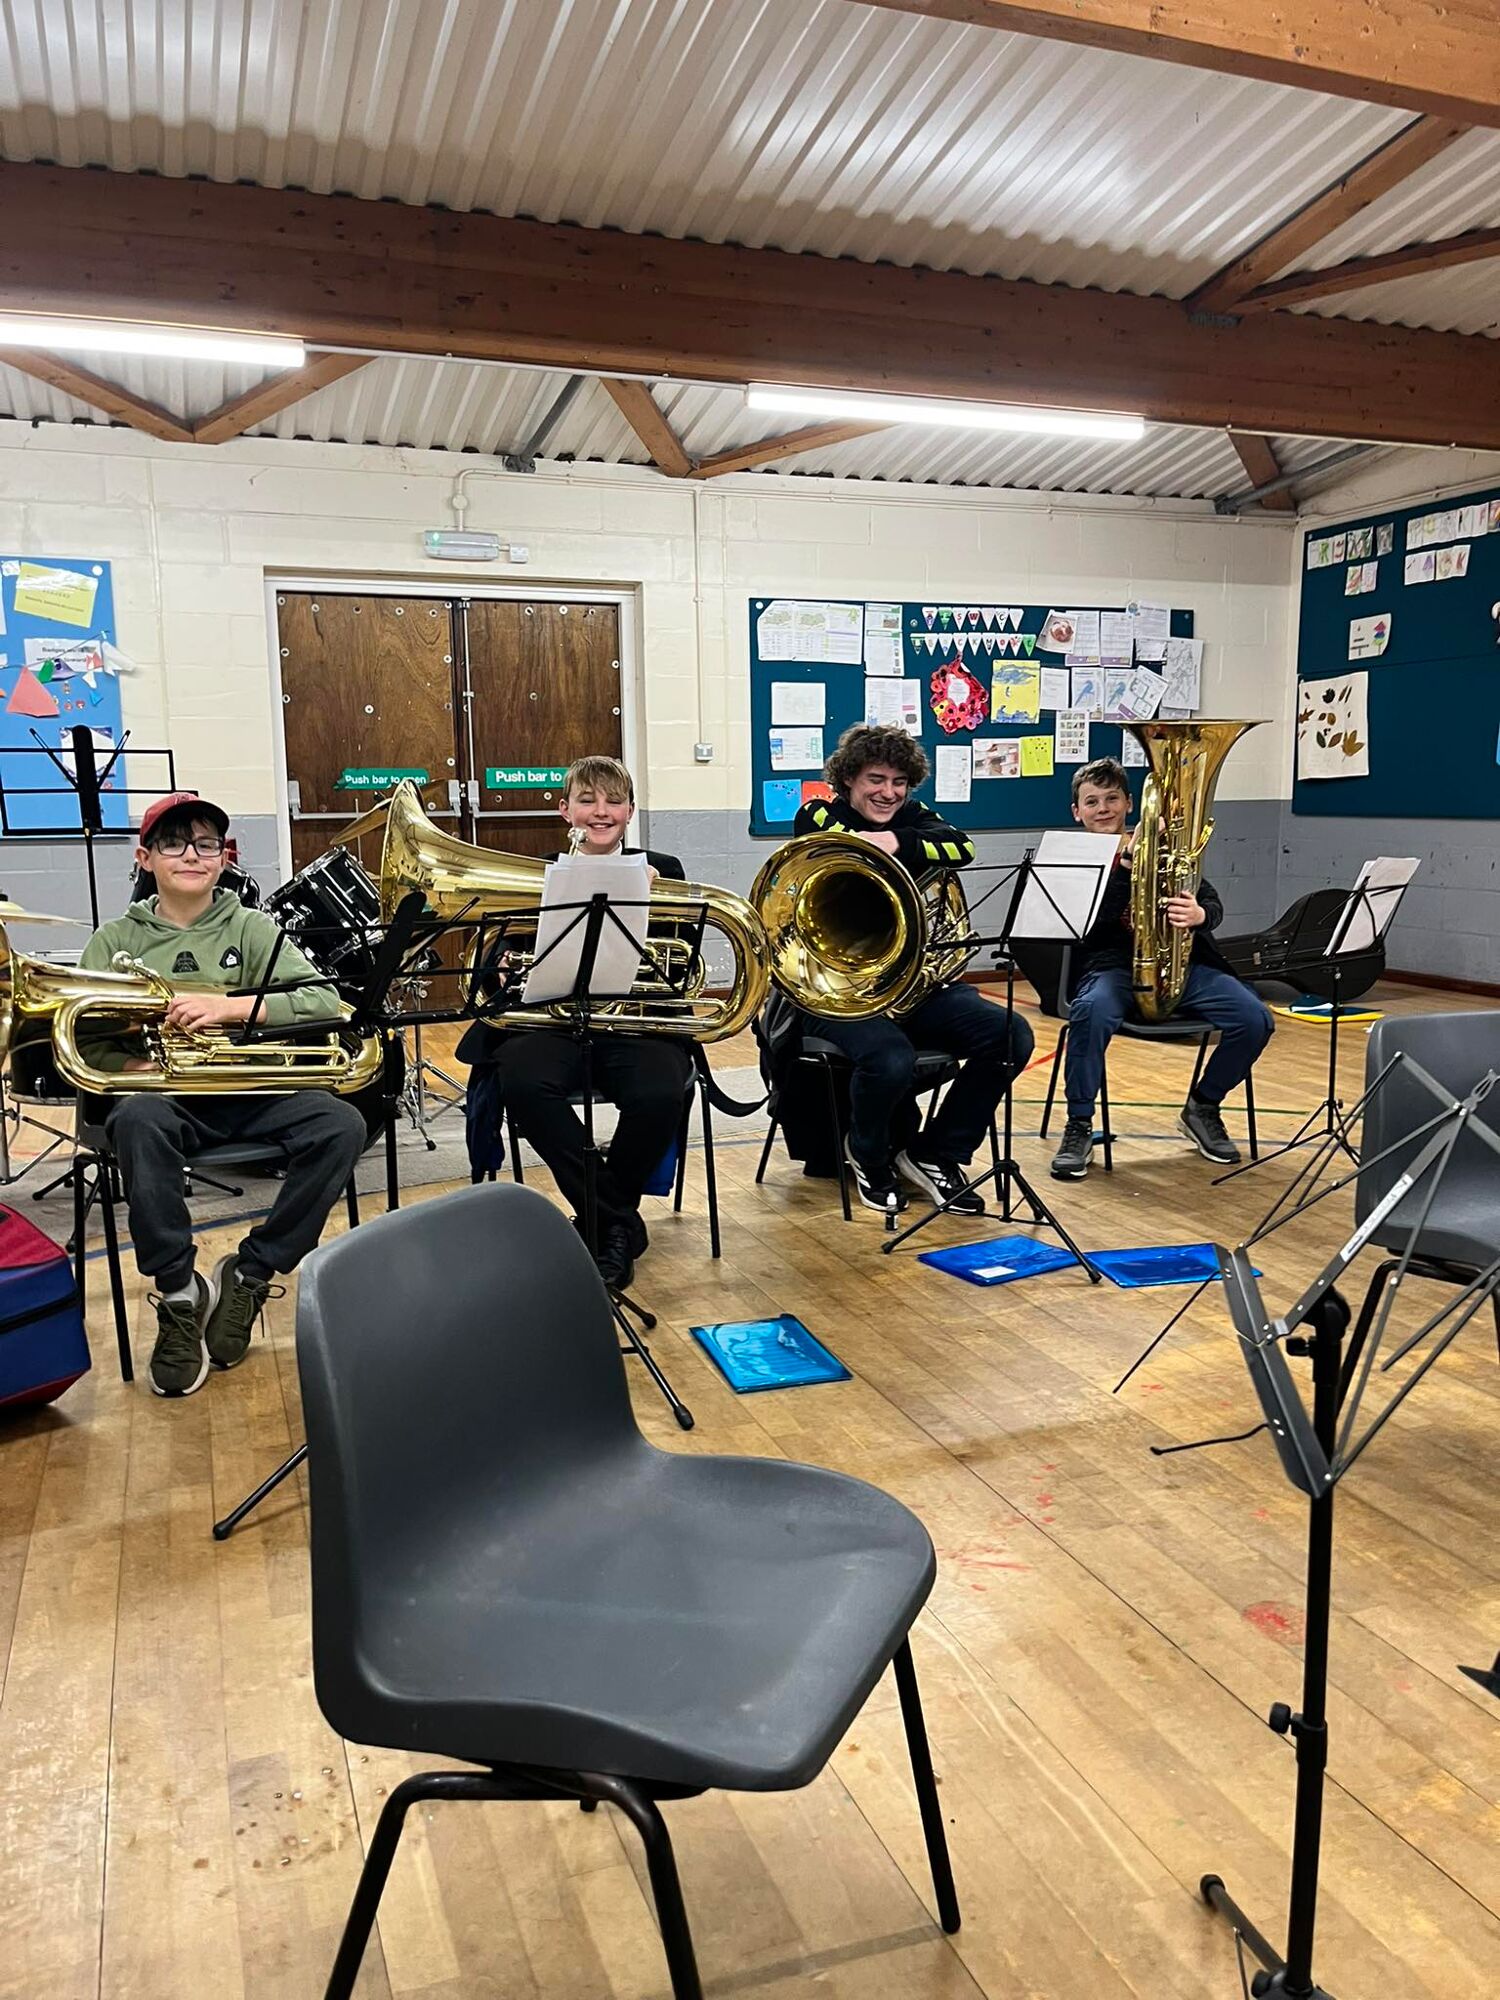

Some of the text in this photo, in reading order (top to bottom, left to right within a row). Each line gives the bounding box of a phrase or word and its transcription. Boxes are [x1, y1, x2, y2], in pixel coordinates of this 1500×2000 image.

[344, 775, 370, 784] Push
[372, 774, 388, 784] bar
[390, 776, 400, 784] to
[495, 770, 563, 783] Push bar to
